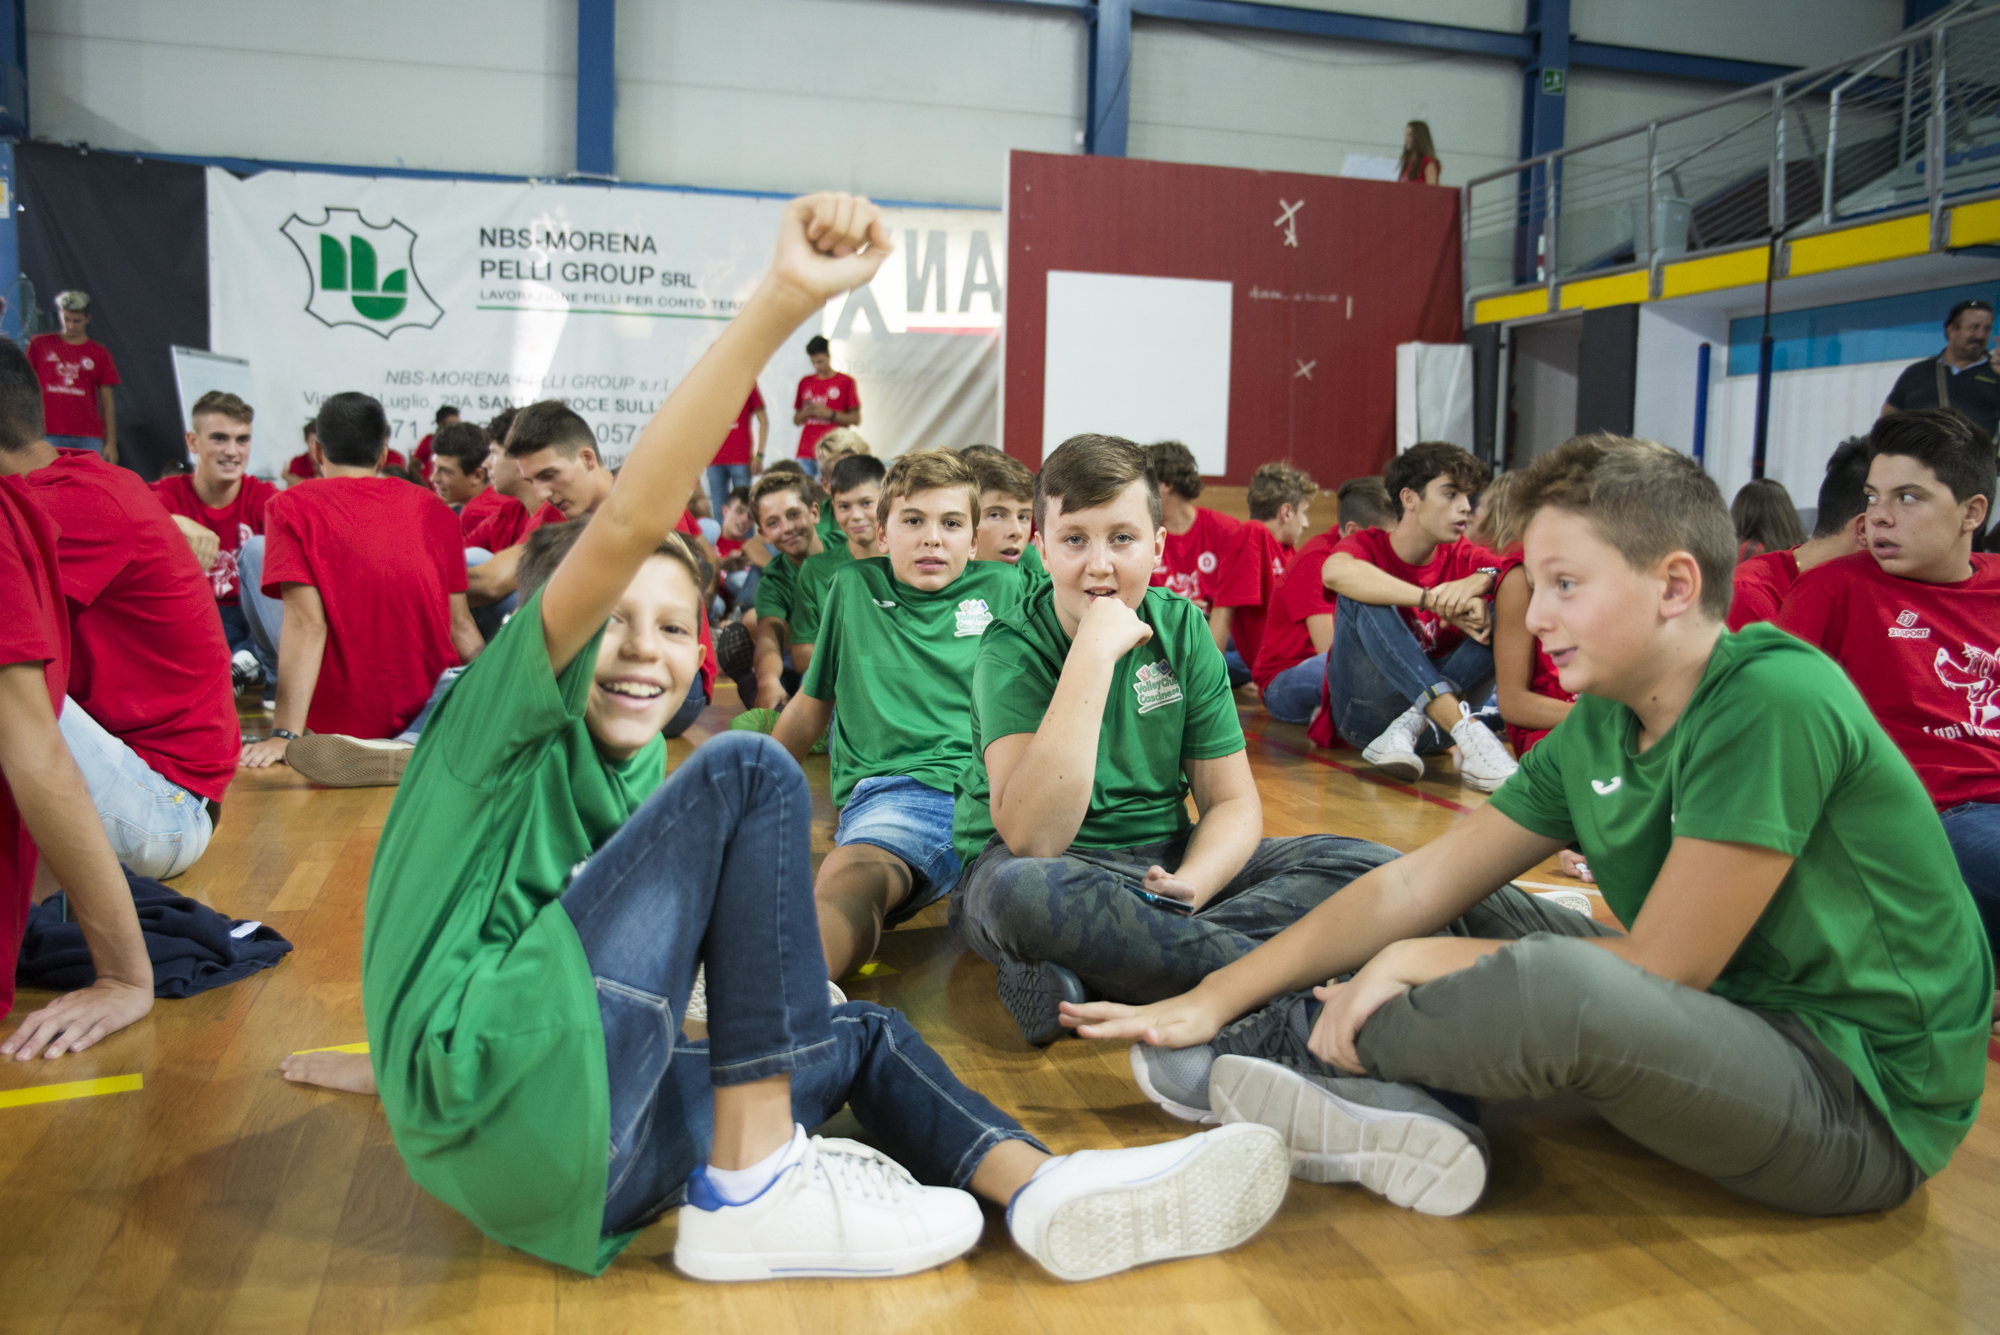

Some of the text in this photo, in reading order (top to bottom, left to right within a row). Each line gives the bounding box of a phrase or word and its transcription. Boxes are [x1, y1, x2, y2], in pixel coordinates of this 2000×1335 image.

[479, 228, 658, 255] NBS-MORENA
[480, 260, 697, 288] PELLI GROUP SRL
[480, 289, 746, 311] LAVORAZIONE PELLI PER CONTO TERZ
[385, 370, 511, 387] NBS-MORENA
[571, 374, 635, 390] GROUP
[562, 398, 609, 413] ROCE
[596, 423, 647, 444] 057
